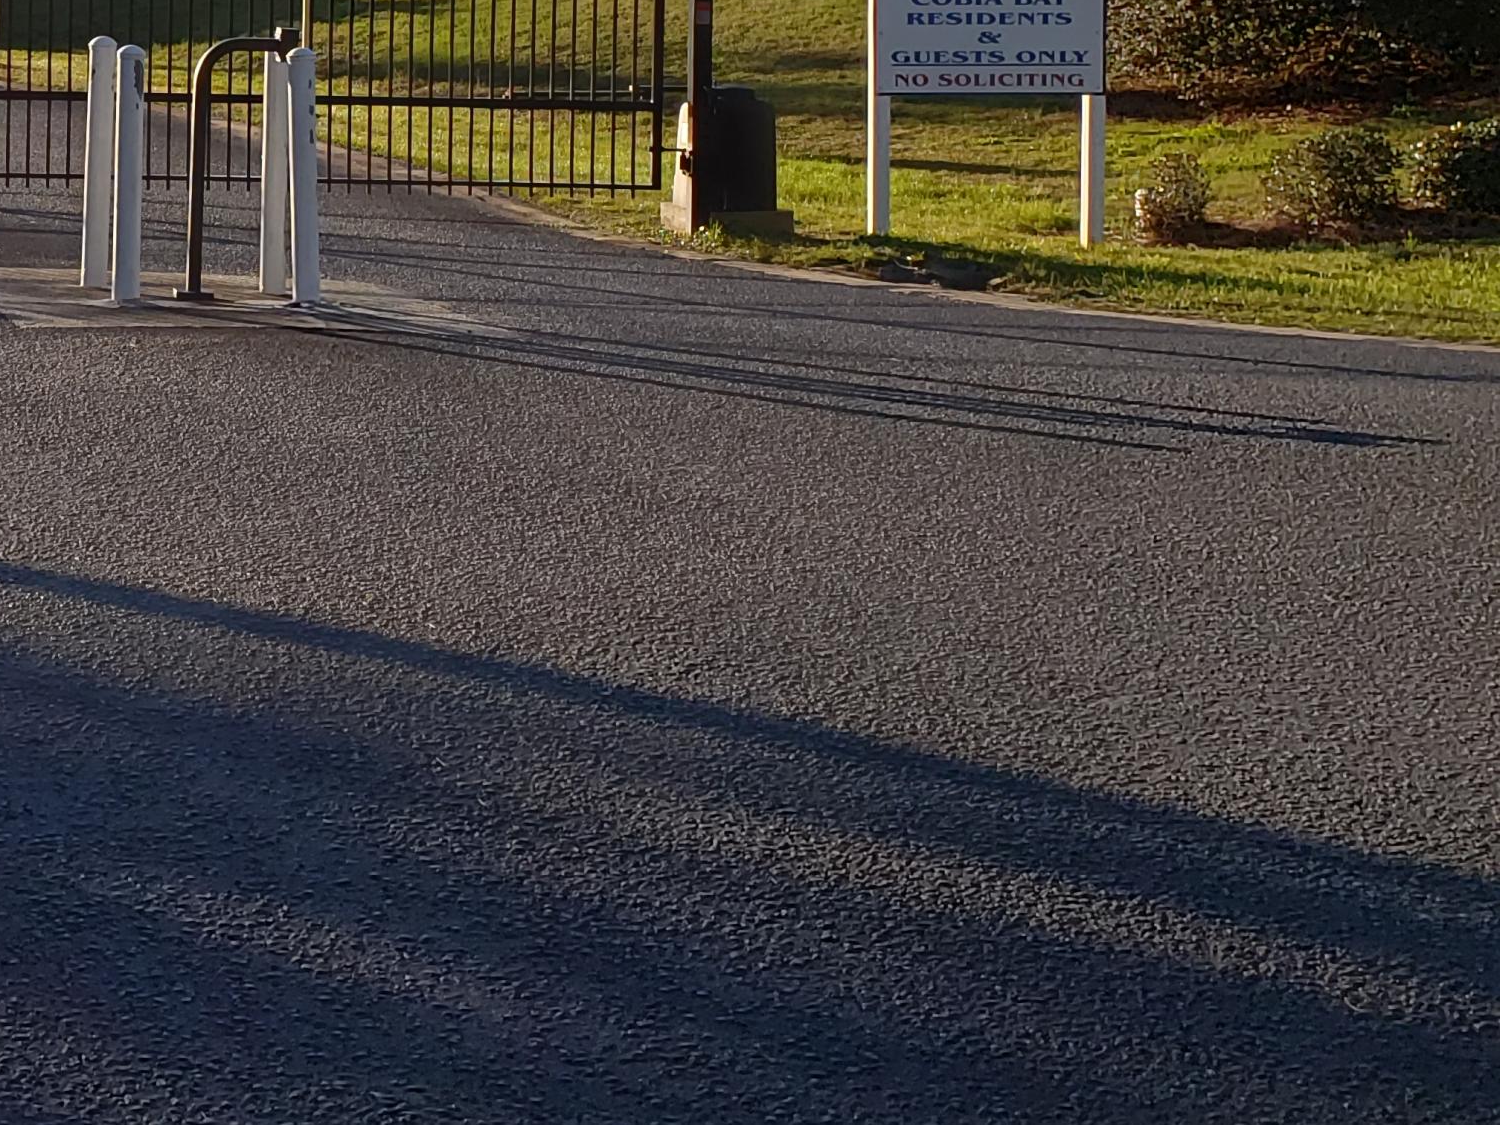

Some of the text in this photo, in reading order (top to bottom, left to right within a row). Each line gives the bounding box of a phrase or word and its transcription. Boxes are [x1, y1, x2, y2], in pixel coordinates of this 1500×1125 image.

[907, 12, 1072, 25] RESIDENTS
[977, 31, 1002, 44] &
[891, 50, 1089, 63] GUESTS ONLY
[894, 73, 1084, 87] NO SOLICITING
